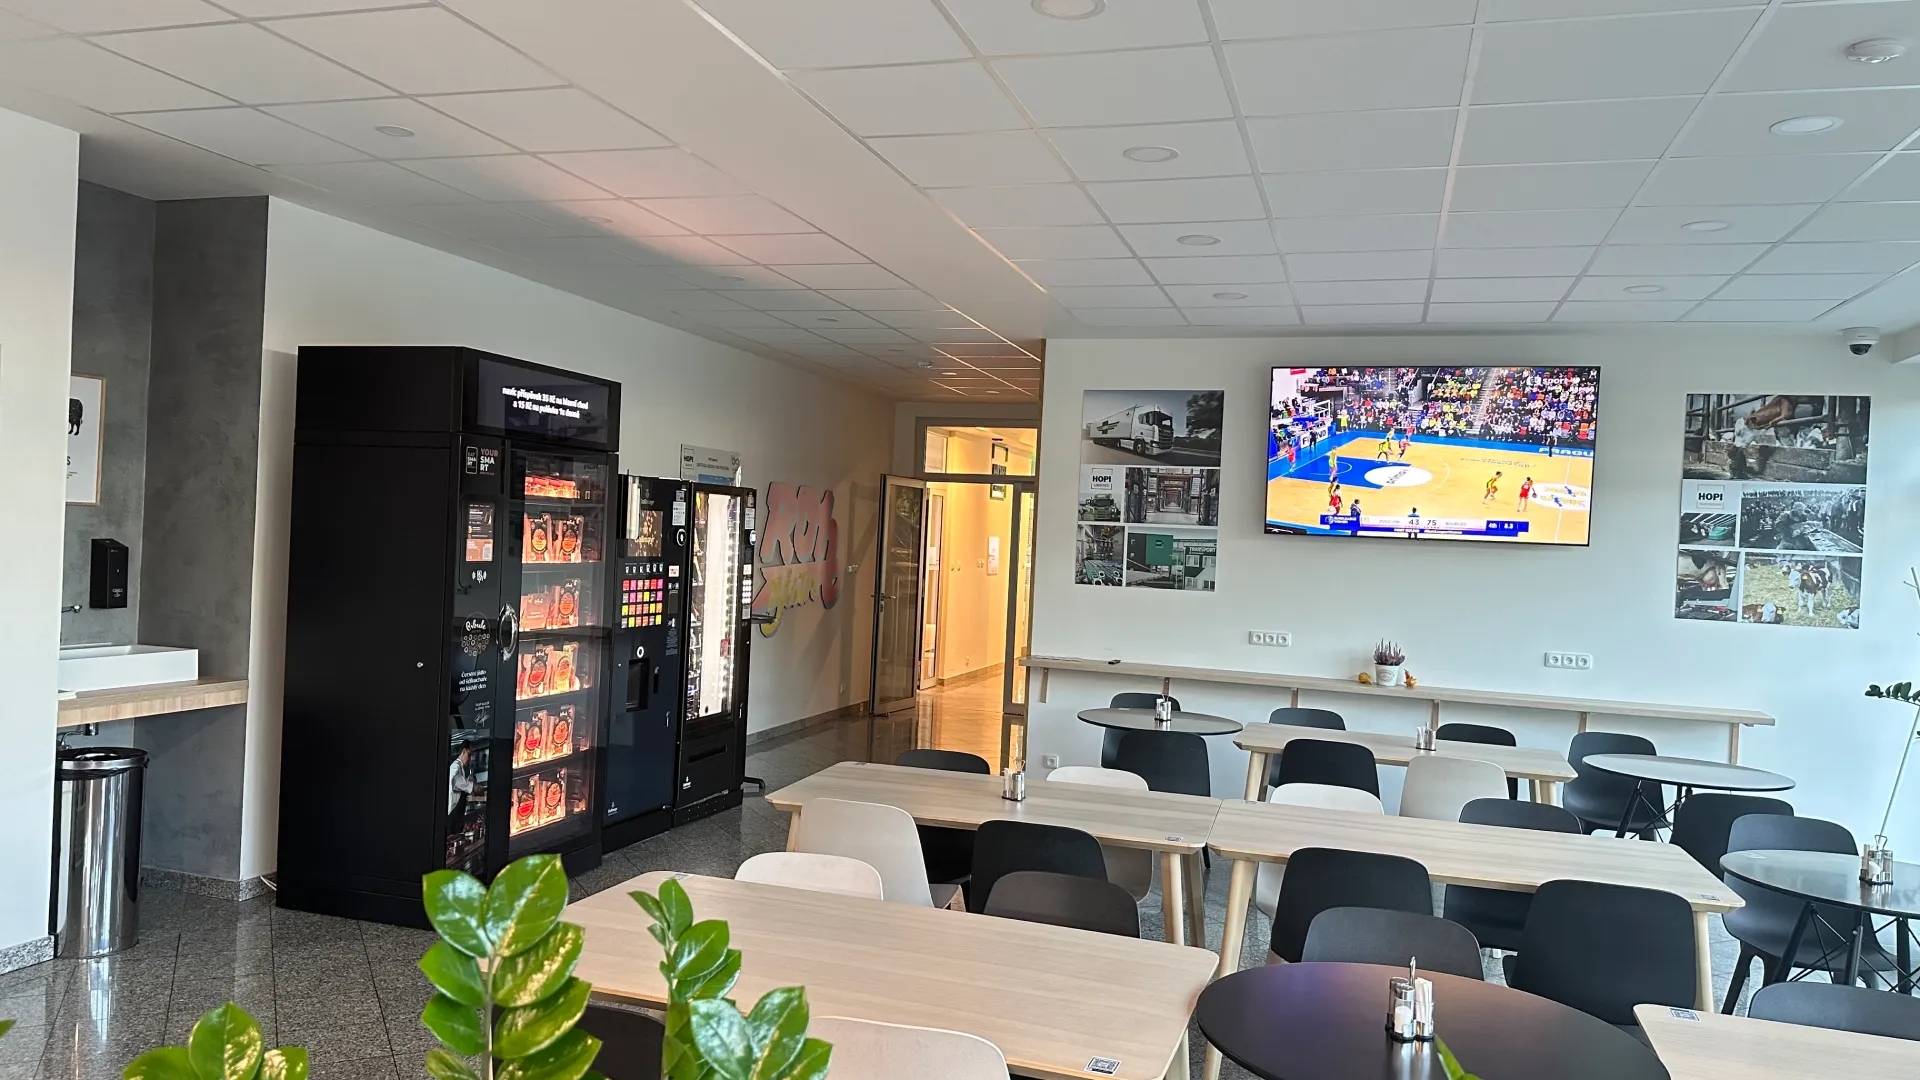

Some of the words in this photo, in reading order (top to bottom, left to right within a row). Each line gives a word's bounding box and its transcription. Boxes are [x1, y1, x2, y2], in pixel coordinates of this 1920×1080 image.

[542, 394, 549, 402] 35
[518, 401, 525, 409] 15
[481, 448, 498, 457] YOUR
[480, 456, 495, 465] SMA
[480, 463, 489, 471] RT
[1092, 475, 1112, 483] HOPI
[1698, 492, 1723, 501] HOPI
